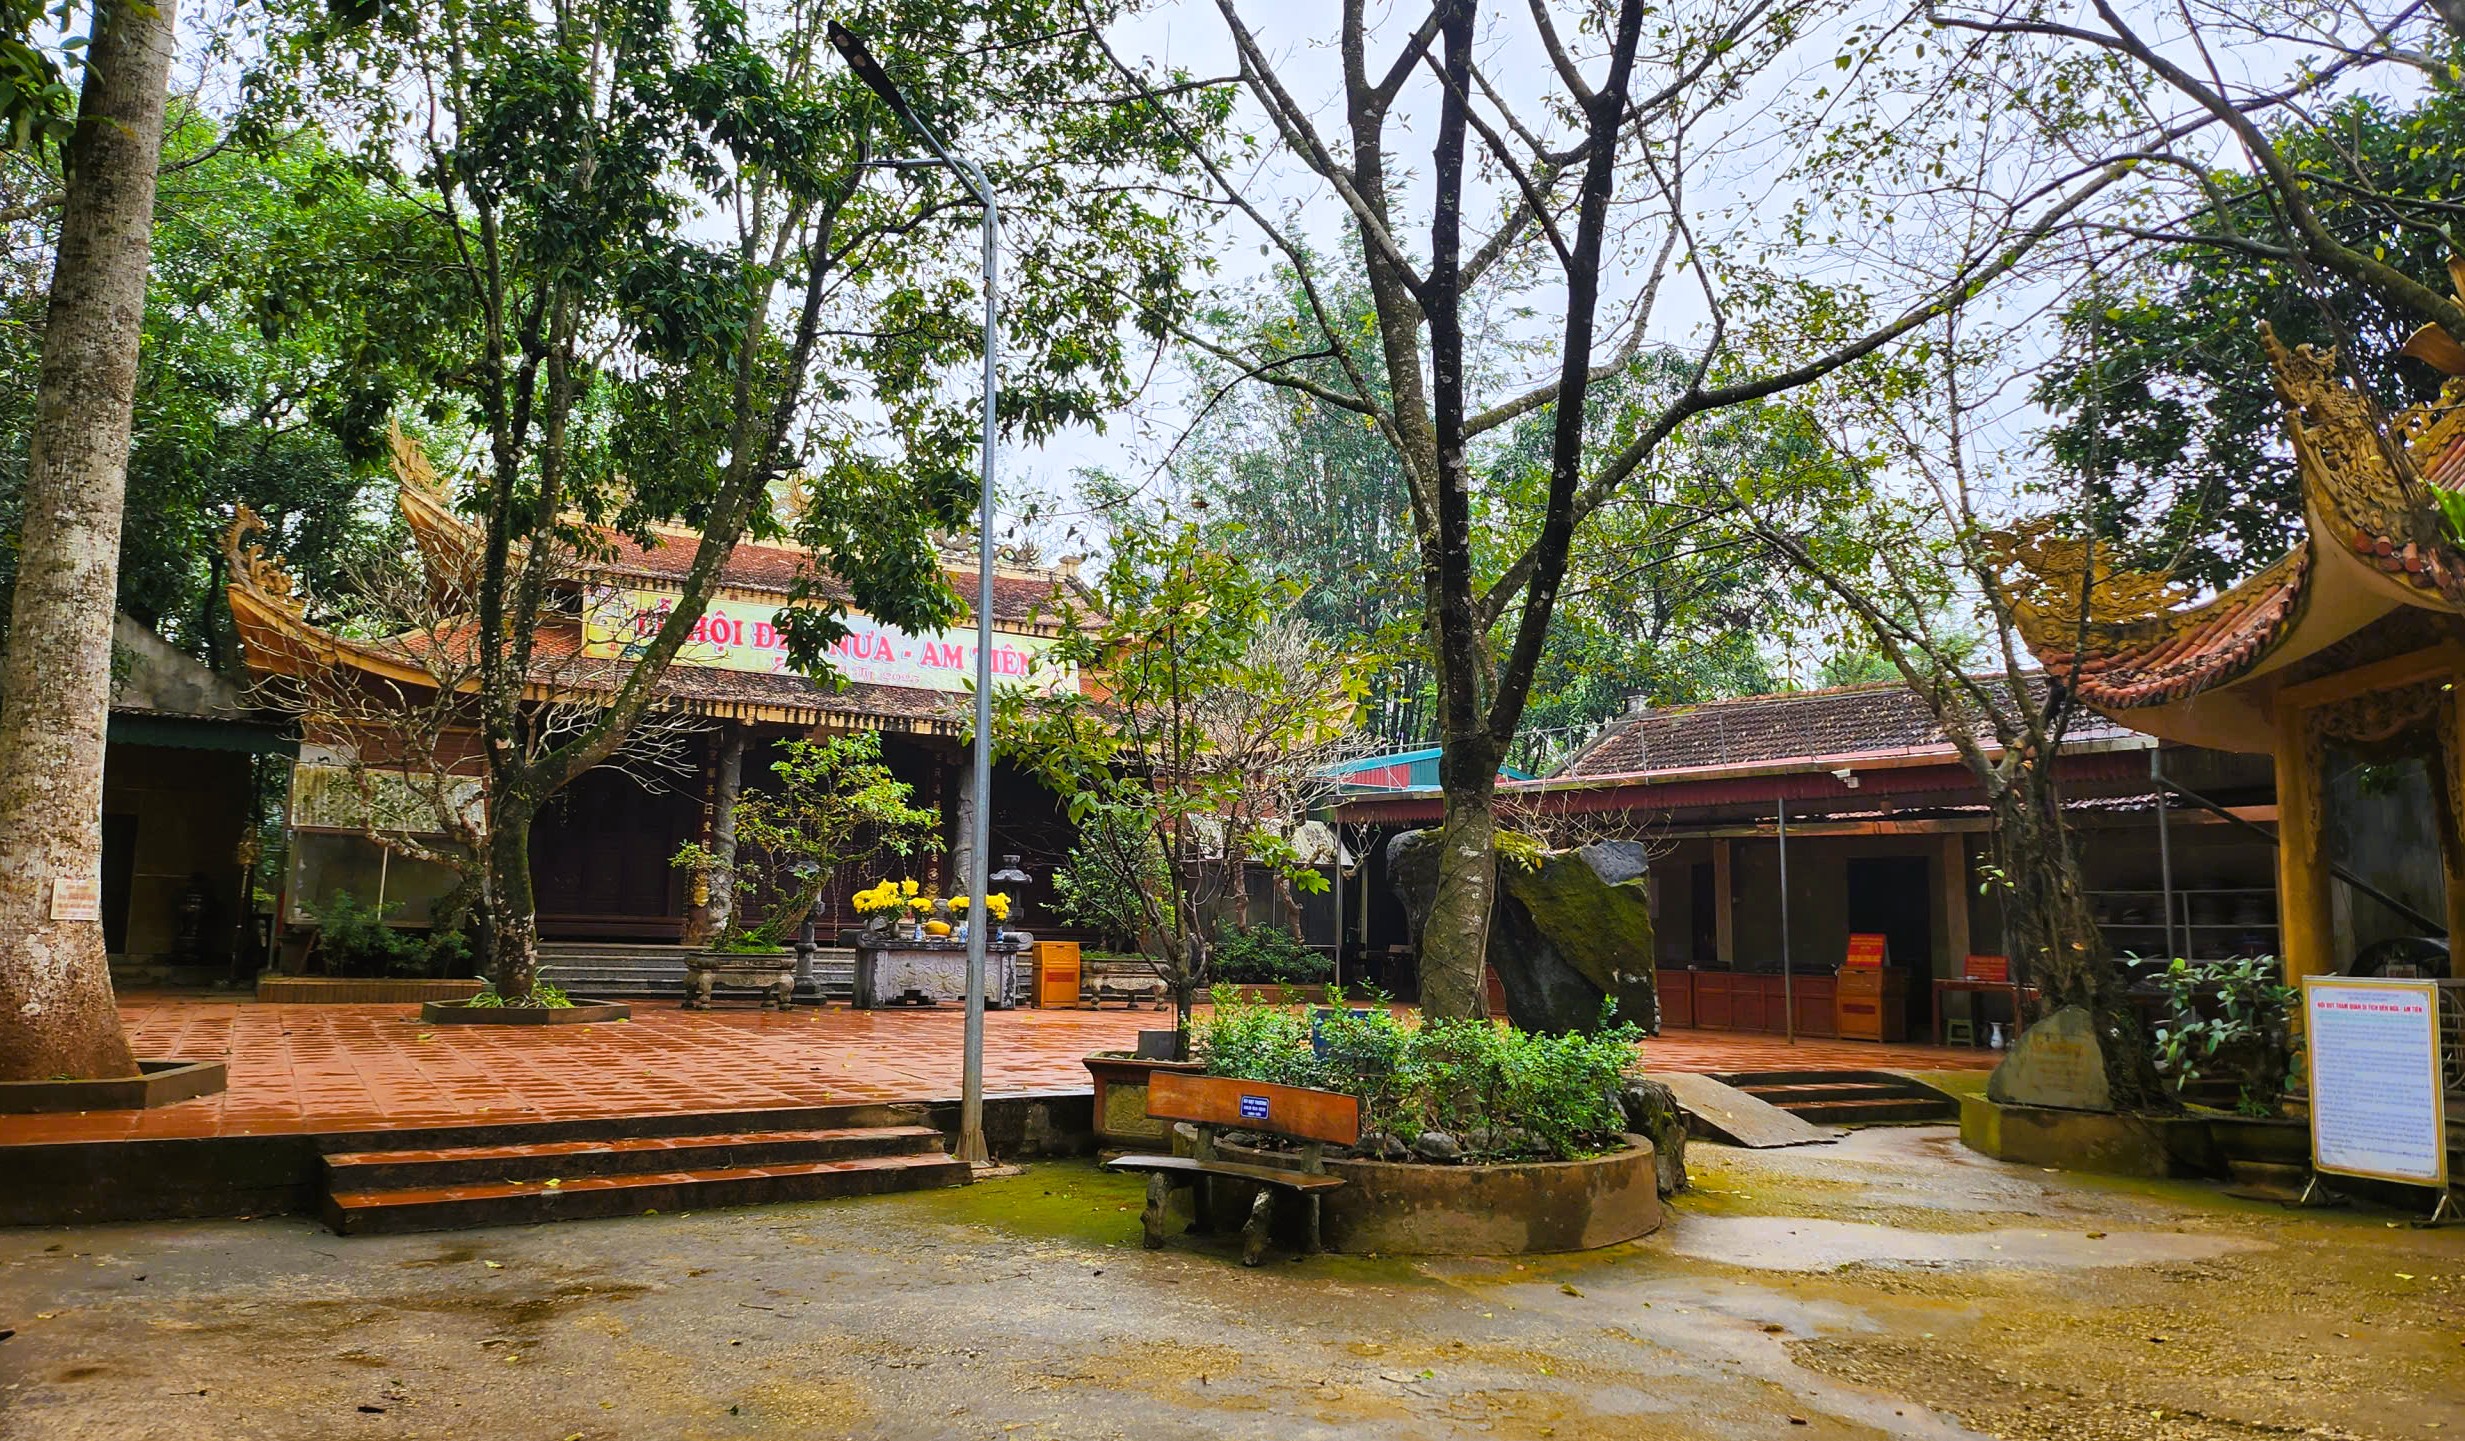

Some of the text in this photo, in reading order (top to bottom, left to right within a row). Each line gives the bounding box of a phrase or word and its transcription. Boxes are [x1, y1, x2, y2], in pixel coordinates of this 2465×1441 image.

[686, 609, 744, 652] HỘI
[919, 641, 965, 671] AM
[971, 643, 1030, 676] IÊN
